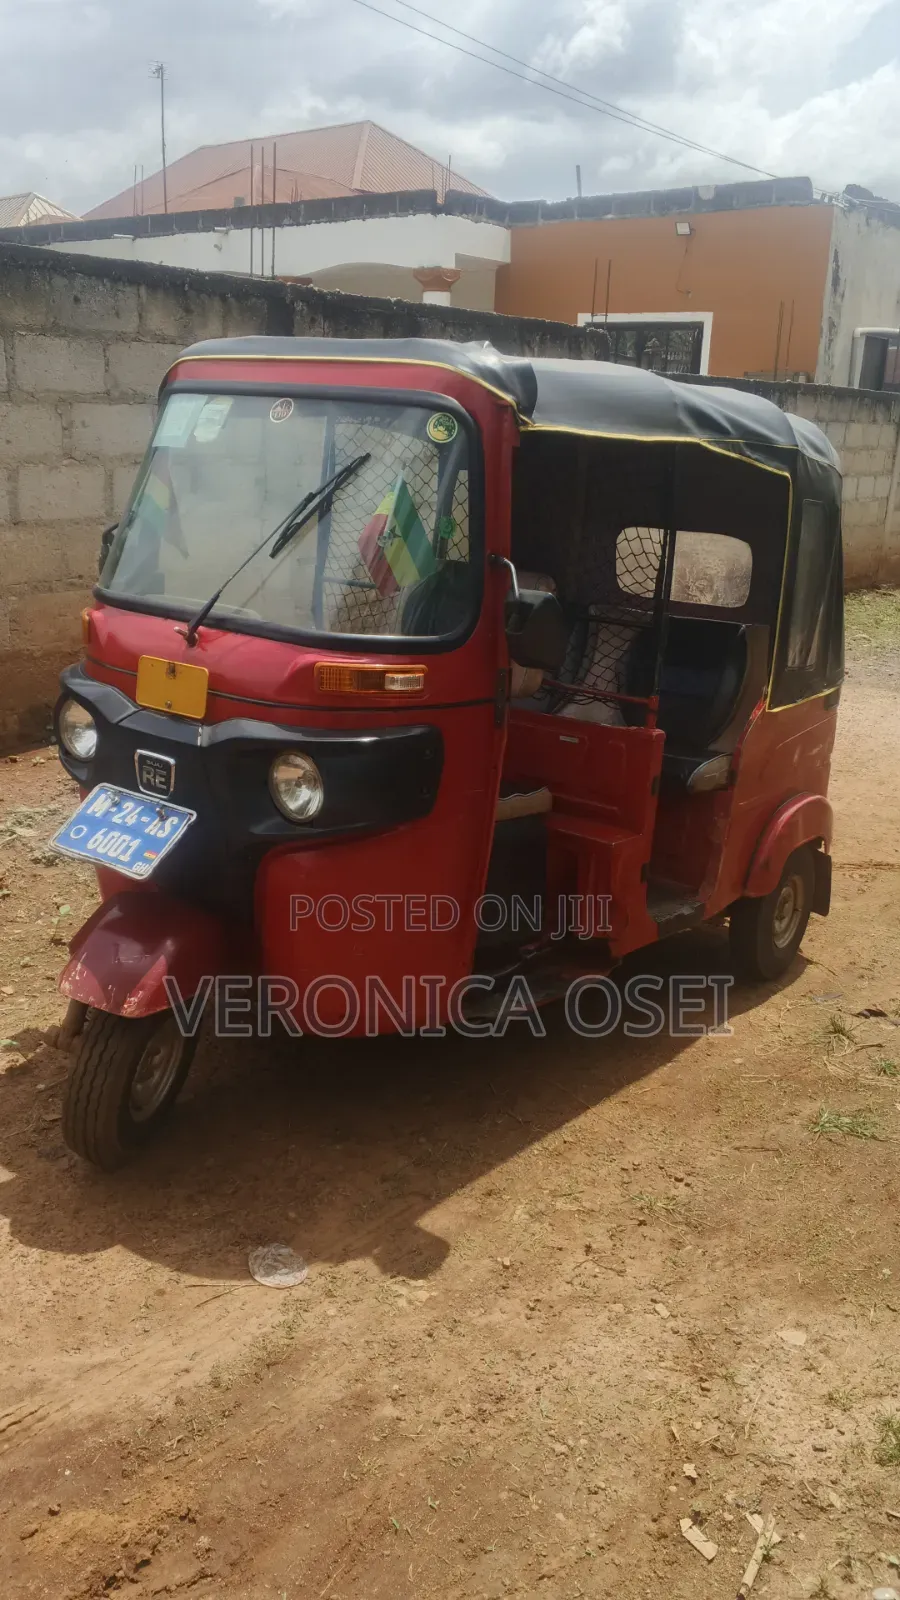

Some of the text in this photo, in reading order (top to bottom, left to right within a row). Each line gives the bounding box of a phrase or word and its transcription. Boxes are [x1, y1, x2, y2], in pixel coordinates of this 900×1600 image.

[142, 765, 167, 790] RE
[86, 792, 180, 838] M-24-AS
[86, 828, 142, 862] 6001
